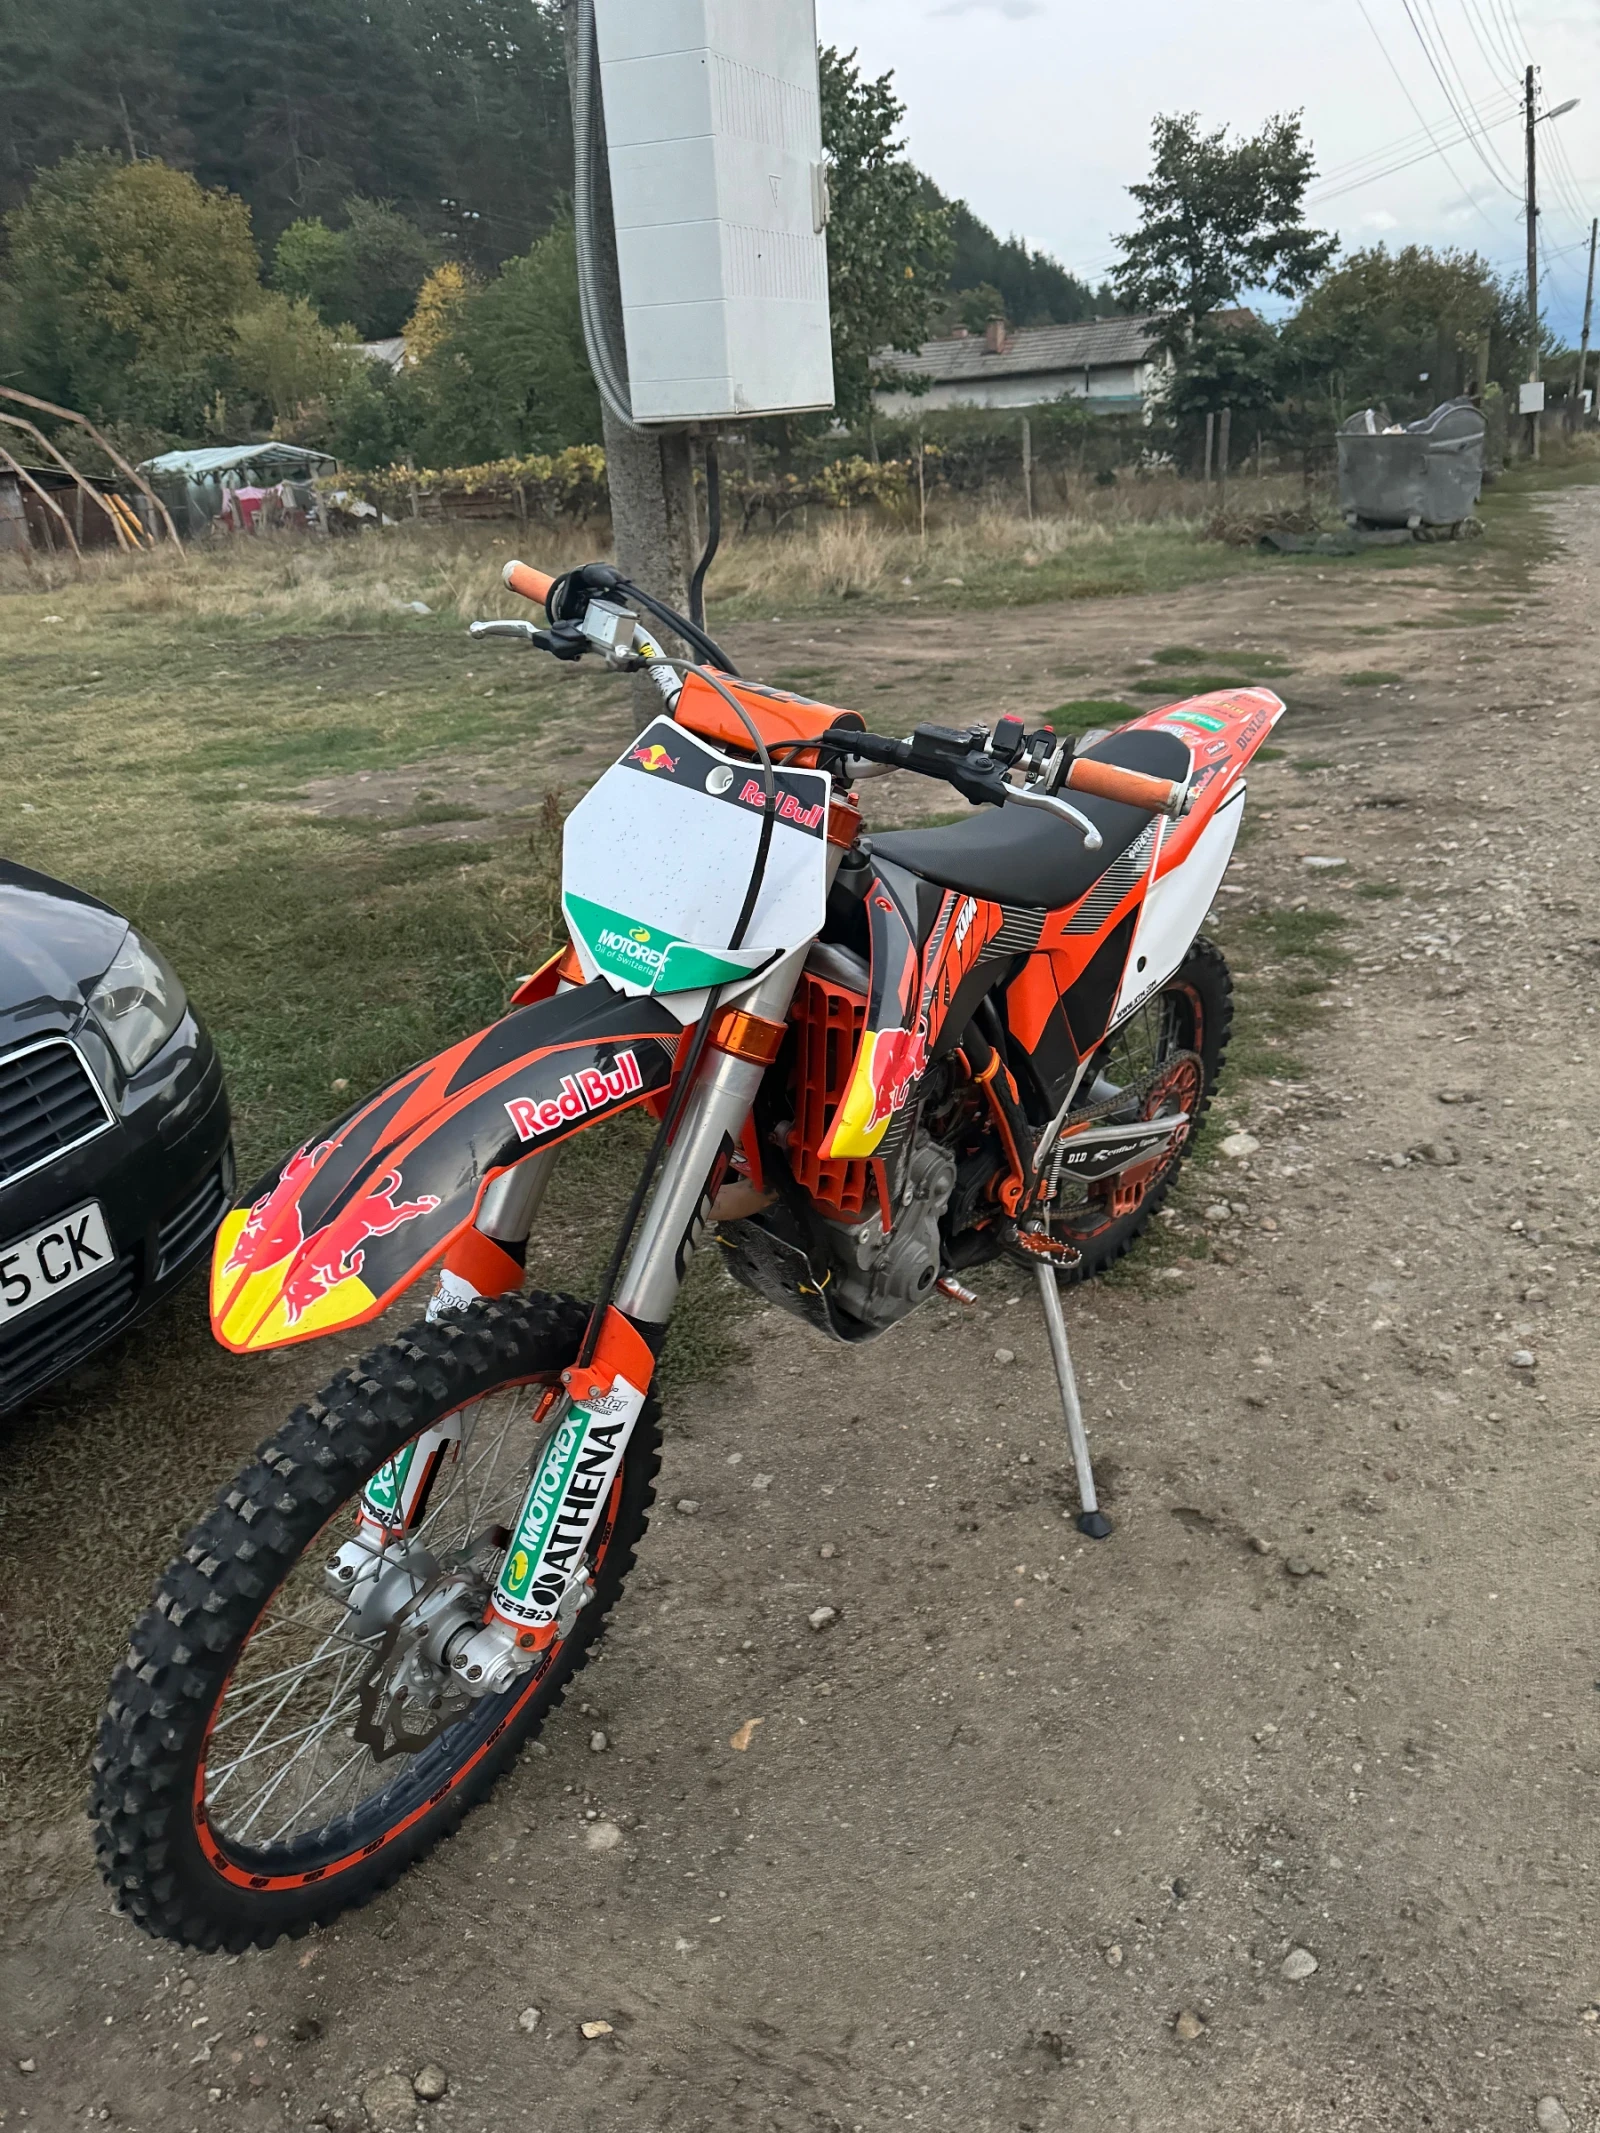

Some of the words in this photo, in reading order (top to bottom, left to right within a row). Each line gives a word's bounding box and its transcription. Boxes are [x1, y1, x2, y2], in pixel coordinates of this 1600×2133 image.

[1236, 709, 1267, 751] DUNLOP
[778, 794, 825, 829] Bull
[595, 943, 607, 954] Oil
[606, 950, 617, 958] of
[598, 929, 670, 973] MOTOREX
[504, 1074, 588, 1143] Red
[575, 1050, 644, 1111] Bull
[1067, 1151, 1088, 1164] DID
[587, 1396, 629, 1412] ster
[519, 1414, 584, 1552] MOTOREX
[543, 1421, 626, 1574] ATHENA
